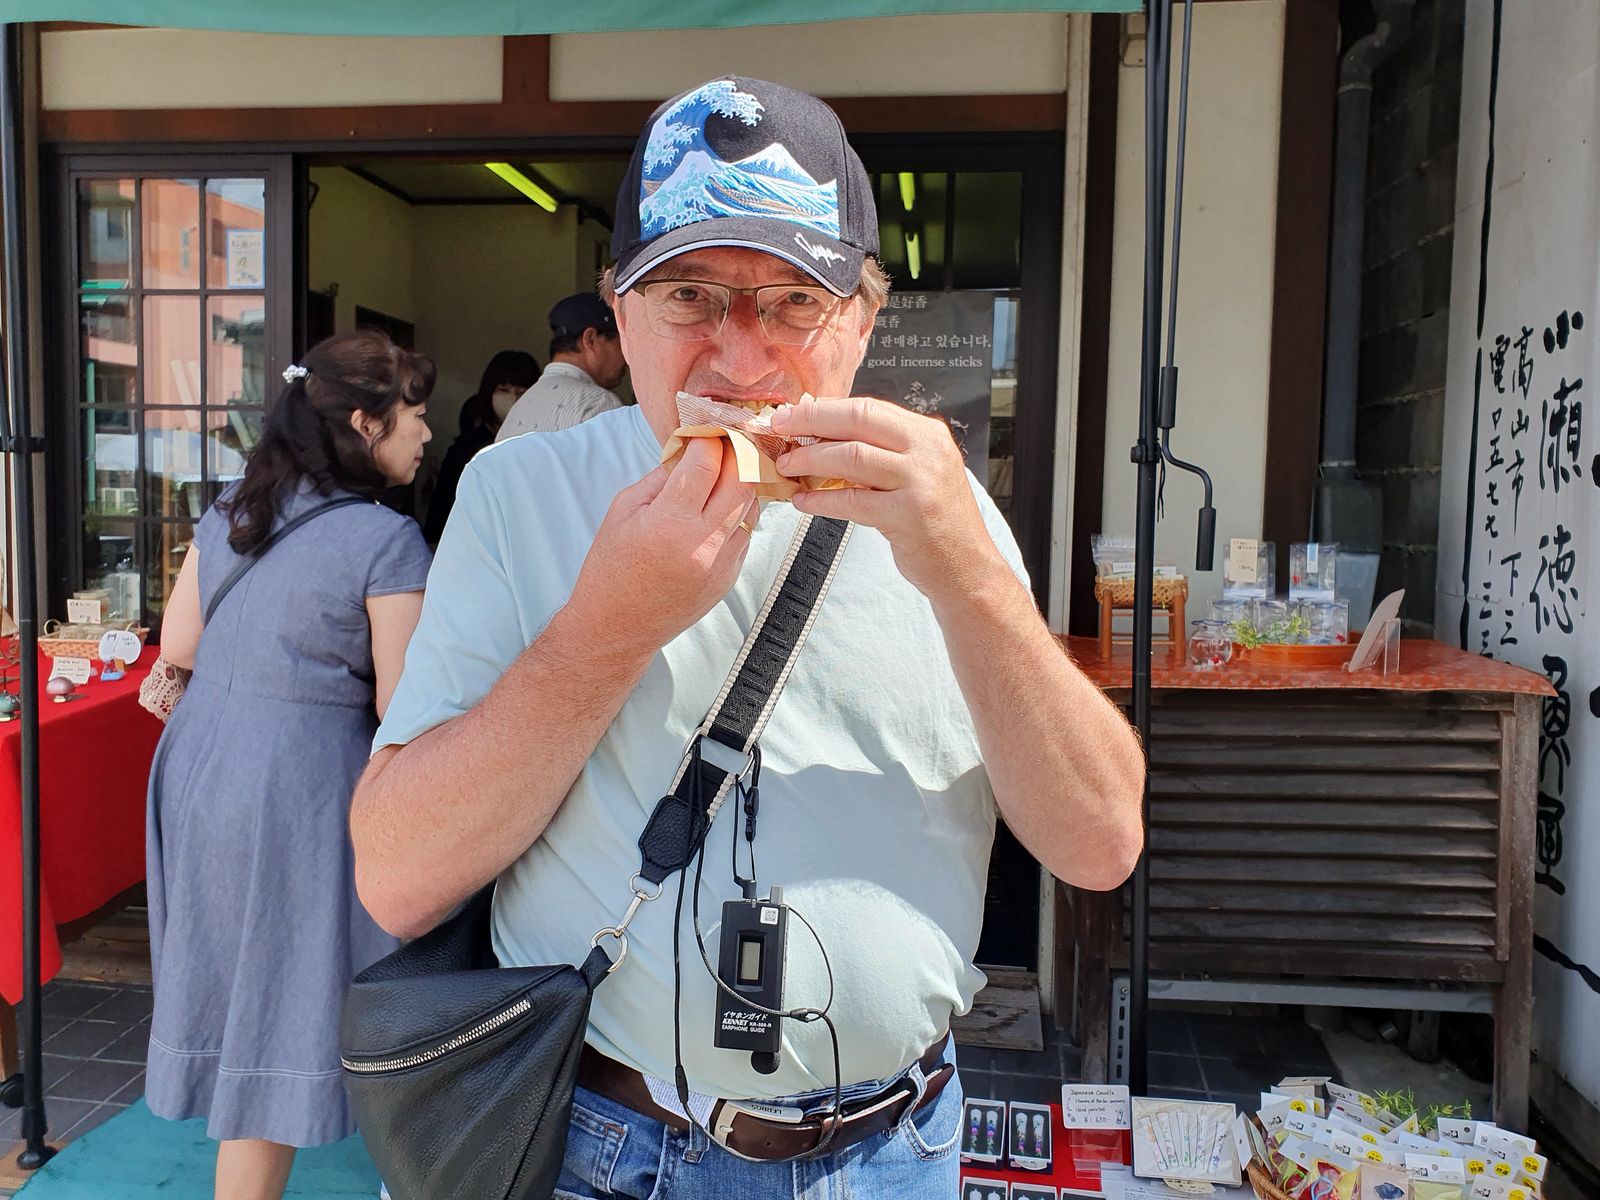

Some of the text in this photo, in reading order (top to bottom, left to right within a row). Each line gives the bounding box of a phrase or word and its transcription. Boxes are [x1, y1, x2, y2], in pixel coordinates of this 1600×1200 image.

[880, 334, 932, 349] 판매하고
[935, 334, 992, 349] 있습니다.
[867, 356, 896, 369] good
[900, 356, 945, 367] incense
[948, 356, 983, 367] sticks
[723, 1011, 769, 1021] イヤホンガイド
